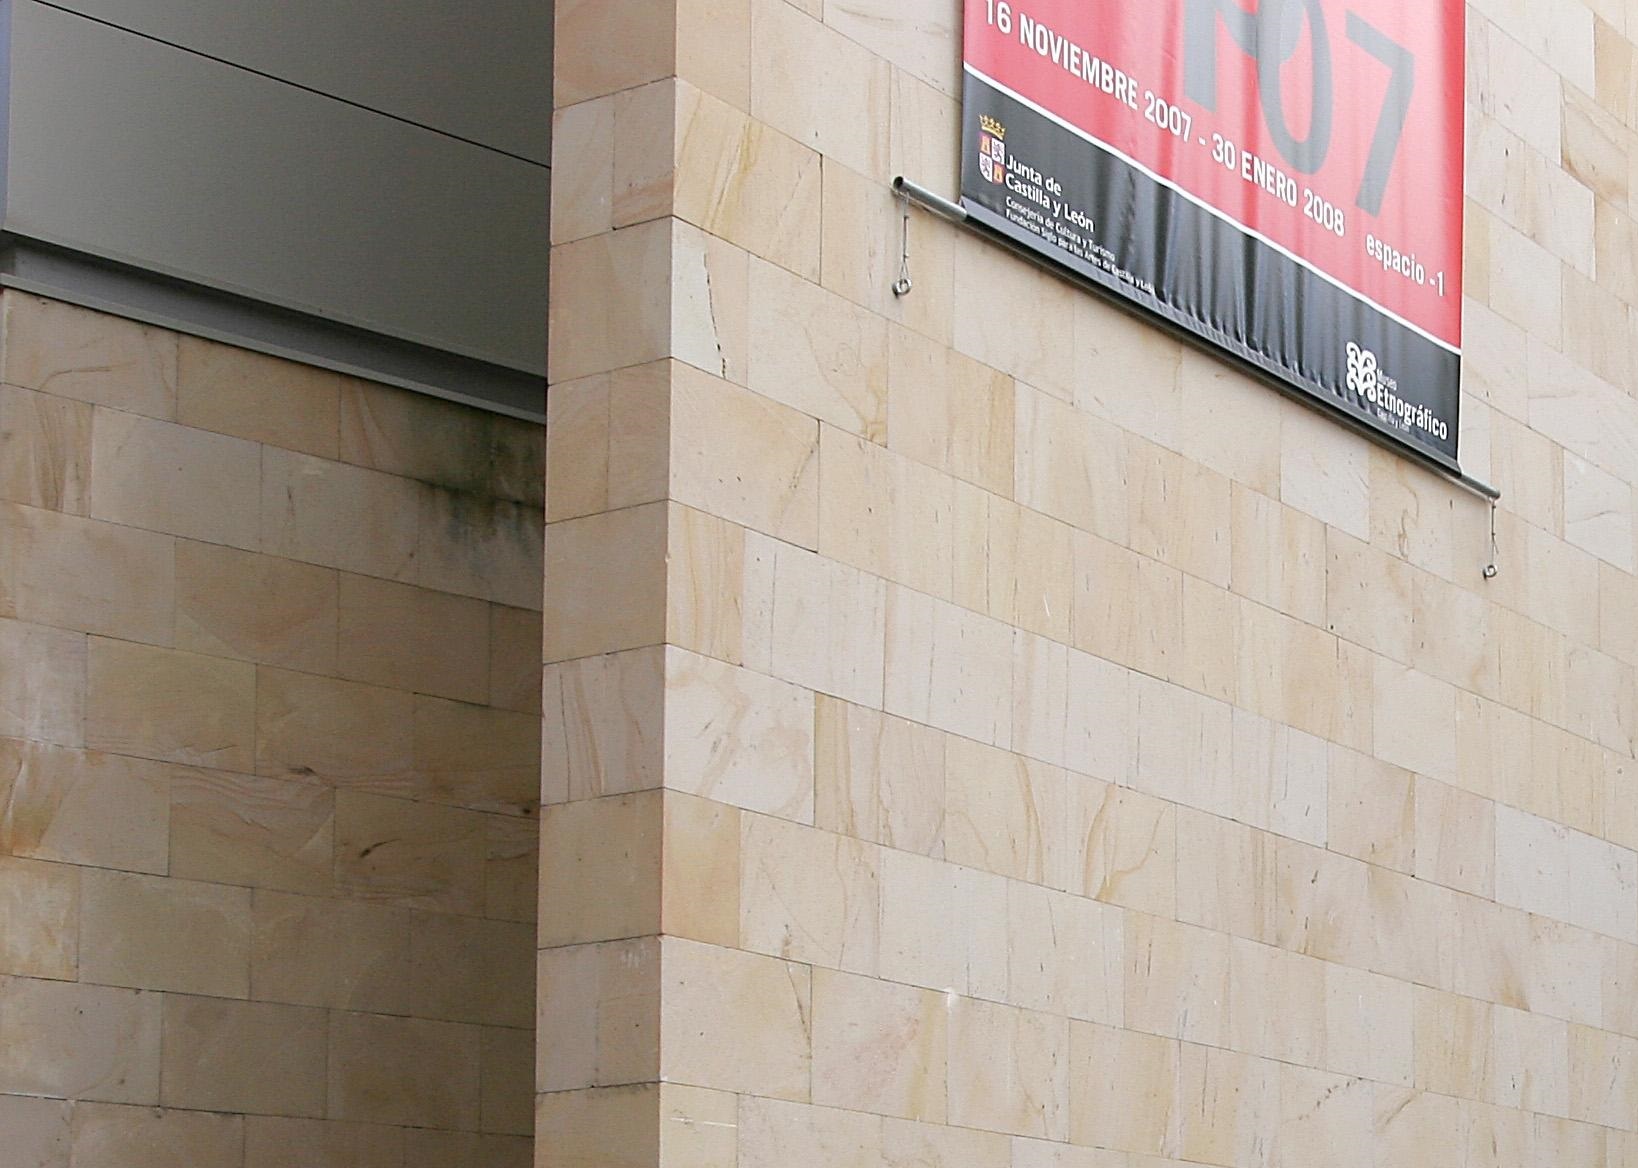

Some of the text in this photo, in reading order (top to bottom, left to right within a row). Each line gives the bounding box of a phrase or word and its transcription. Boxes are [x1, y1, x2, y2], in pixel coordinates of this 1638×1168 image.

[985, 0, 1012, 34] 16
[1019, 13, 1139, 110] NOVIEMBRE
[1144, 90, 1192, 142] 2007
[1211, 133, 1237, 170] 30
[1241, 150, 1298, 208] ENERO
[1303, 189, 1345, 237] 2008
[1005, 155, 1062, 197] Junta de
[1005, 173, 1095, 232] Castilla y León
[1055, 222, 1081, 244] Cultura
[1366, 234, 1425, 285] espacio
[1376, 382, 1447, 440] Etnográfico
